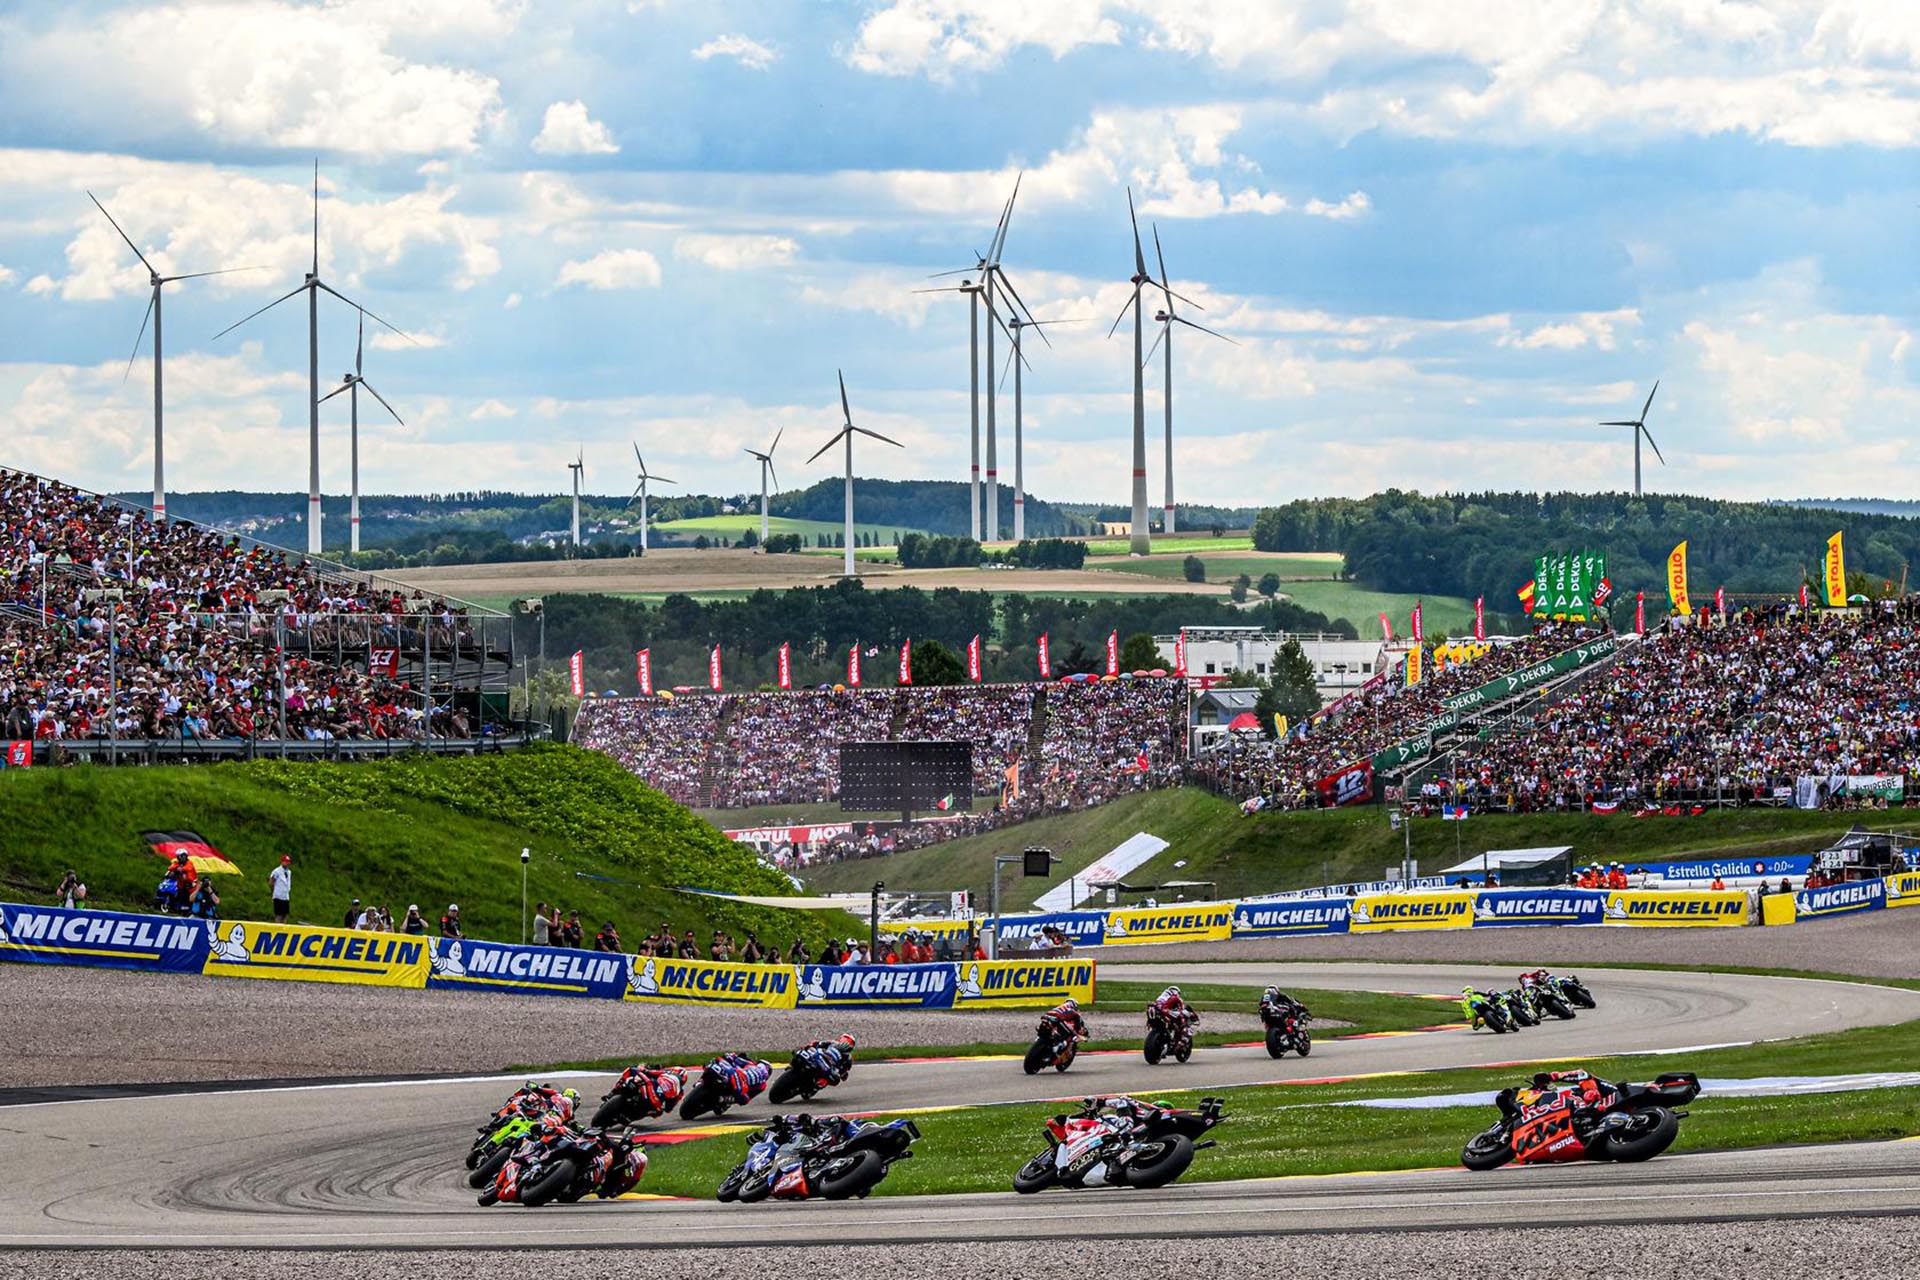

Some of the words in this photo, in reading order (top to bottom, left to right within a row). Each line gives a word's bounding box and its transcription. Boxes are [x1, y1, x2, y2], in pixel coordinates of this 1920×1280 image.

[1521, 662, 1556, 683] DEKRA
[1450, 690, 1485, 710] DEKRA
[1335, 769, 1365, 796] 12
[736, 829, 792, 843] MOTUL
[1668, 865, 1710, 879] Estrella
[1711, 862, 1751, 877] Galicia
[1812, 882, 1881, 908] MICHELIN
[1372, 900, 1467, 918] MICHELIN
[1496, 898, 1598, 915] MICHELIN
[1628, 900, 1743, 916] MICHELIN
[1128, 912, 1229, 932] MICHELIN
[1253, 907, 1346, 928] MICHELIN
[12, 913, 199, 950] MICHELIN
[253, 932, 423, 965] MICHELIN
[468, 948, 620, 984] MICHELIN
[661, 966, 790, 994] MICHELIN
[827, 970, 948, 994] MICHELIN
[983, 966, 1092, 989] MICHELIN
[1549, 1136, 1576, 1153] MOTUL
